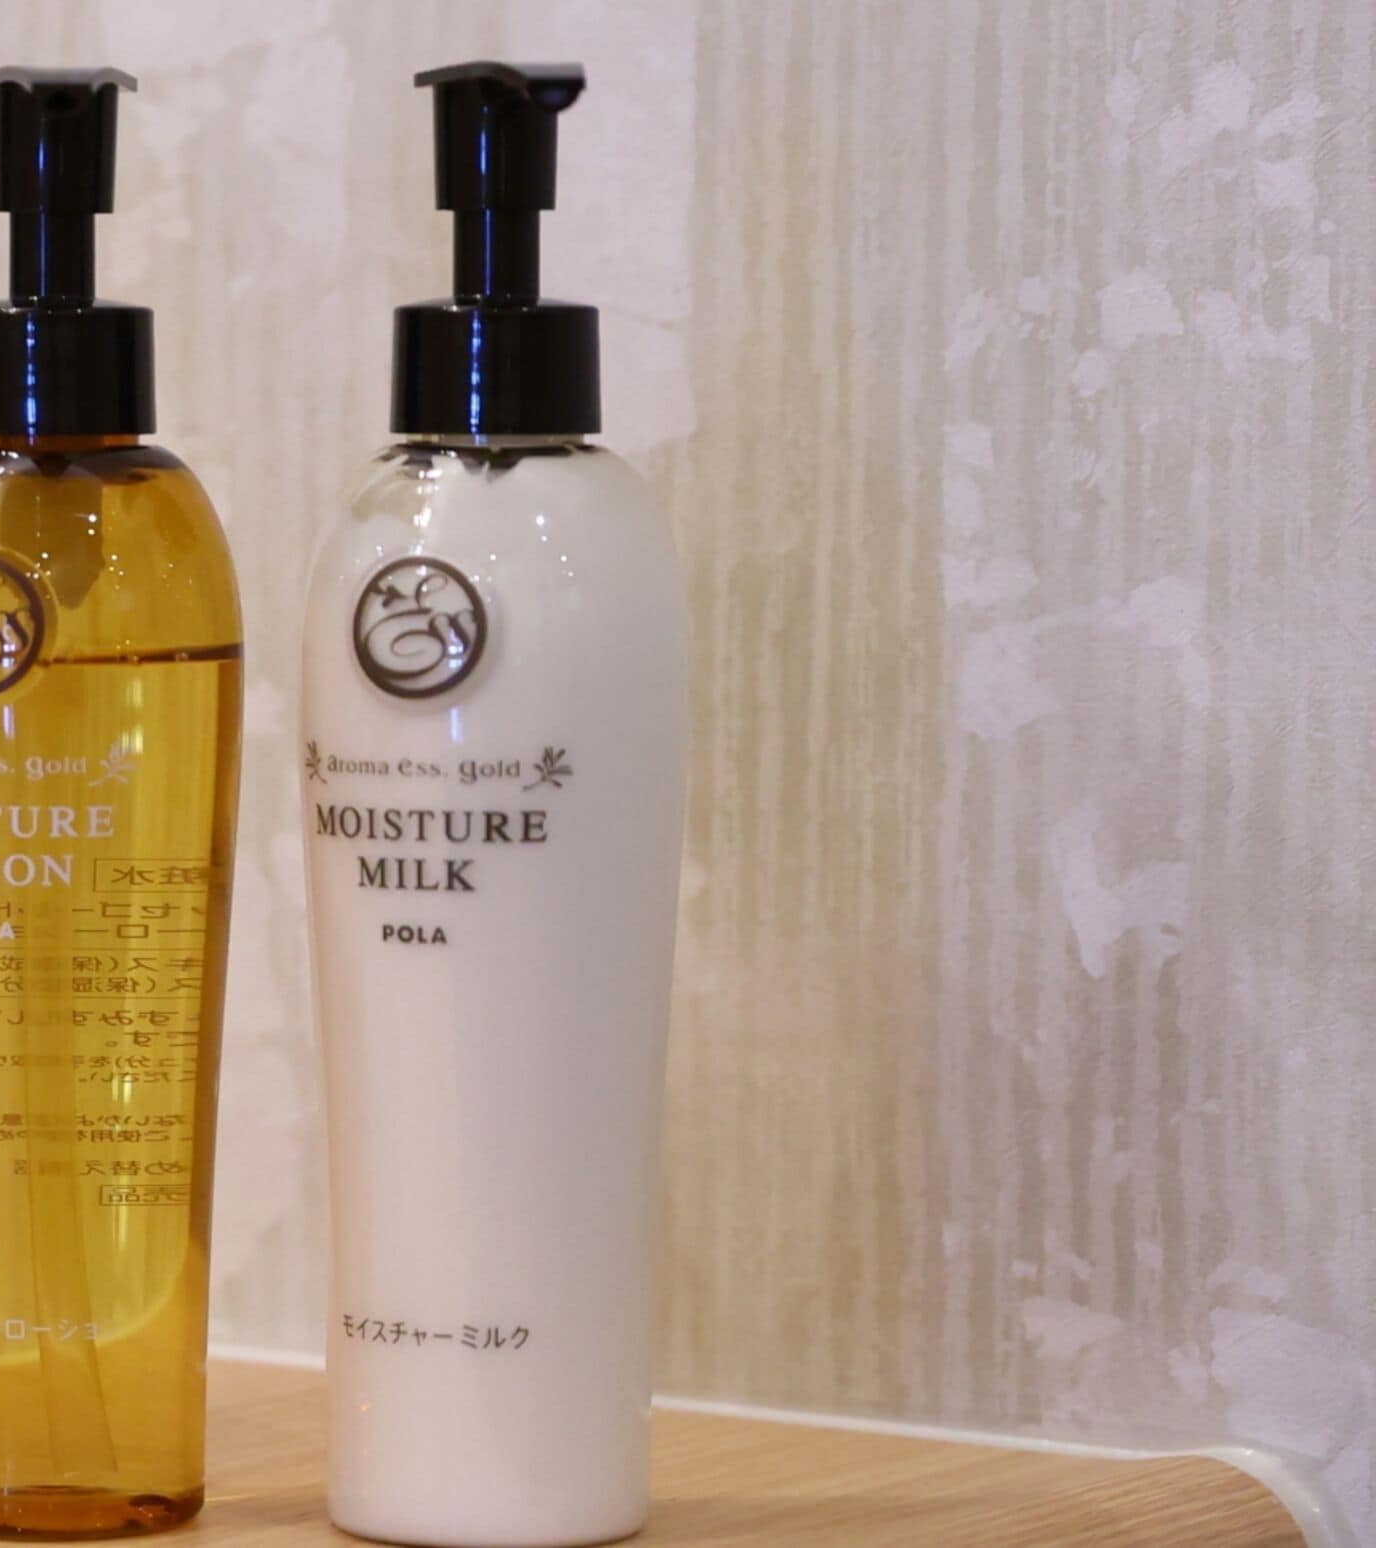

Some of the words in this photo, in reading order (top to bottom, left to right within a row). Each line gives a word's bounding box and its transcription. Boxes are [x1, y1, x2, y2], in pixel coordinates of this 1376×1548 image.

[25, 756, 88, 780] gold
[327, 755, 389, 776] aroma
[459, 760, 521, 784] gold
[316, 803, 548, 844] MOISTURE
[358, 856, 476, 892] MILK
[382, 924, 448, 945] POLA
[342, 1314, 530, 1350] モイスチャーミルク
